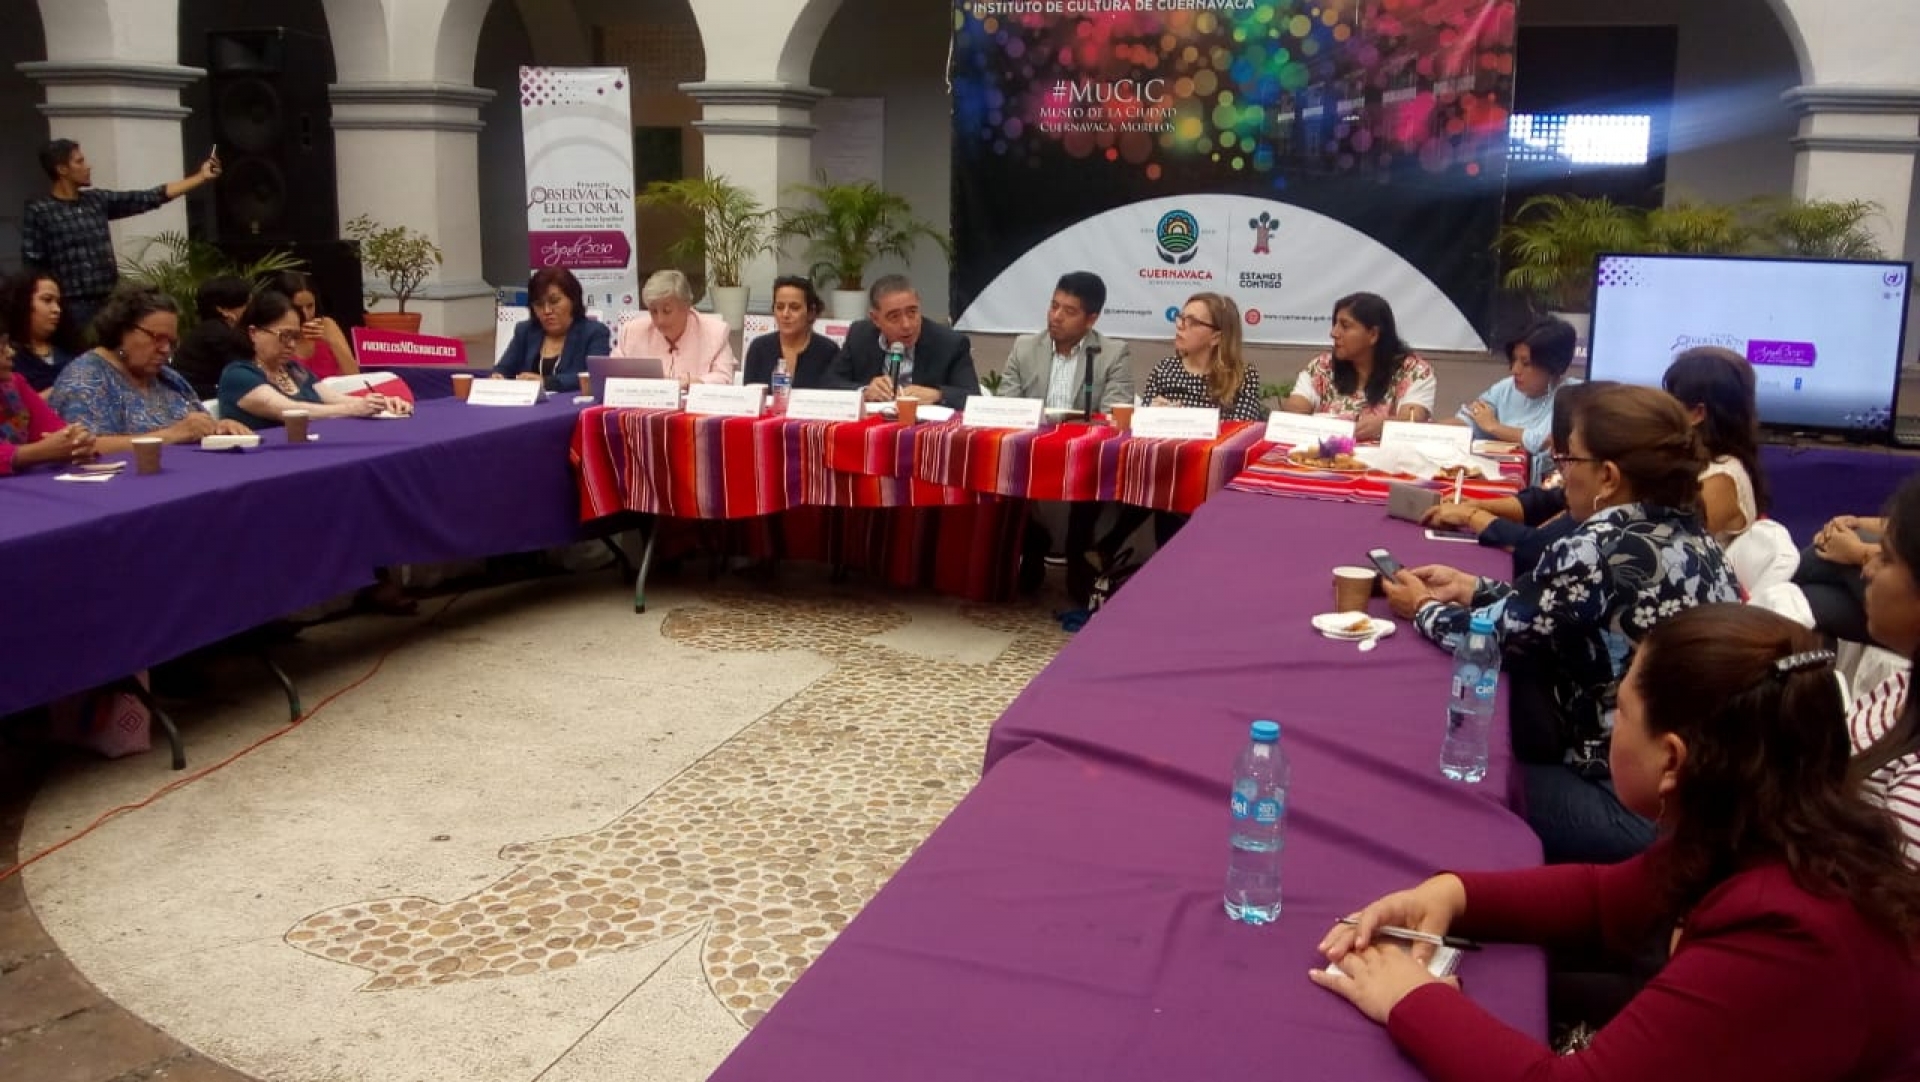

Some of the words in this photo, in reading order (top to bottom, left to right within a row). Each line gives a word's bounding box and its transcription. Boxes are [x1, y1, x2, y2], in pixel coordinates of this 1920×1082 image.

[973, 1, 1042, 13] INSTITUTO
[1046, 0, 1063, 13] DE
[1067, 0, 1132, 12] CULTURA
[1135, 0, 1153, 11] DE
[1157, 0, 1255, 10] CUERNAVACA
[543, 203, 624, 214] ELECTORAL
[1139, 268, 1213, 280] CUERNAVACA
[1239, 272, 1283, 280] ESTAMOS
[1239, 281, 1282, 289] CONTIGO
